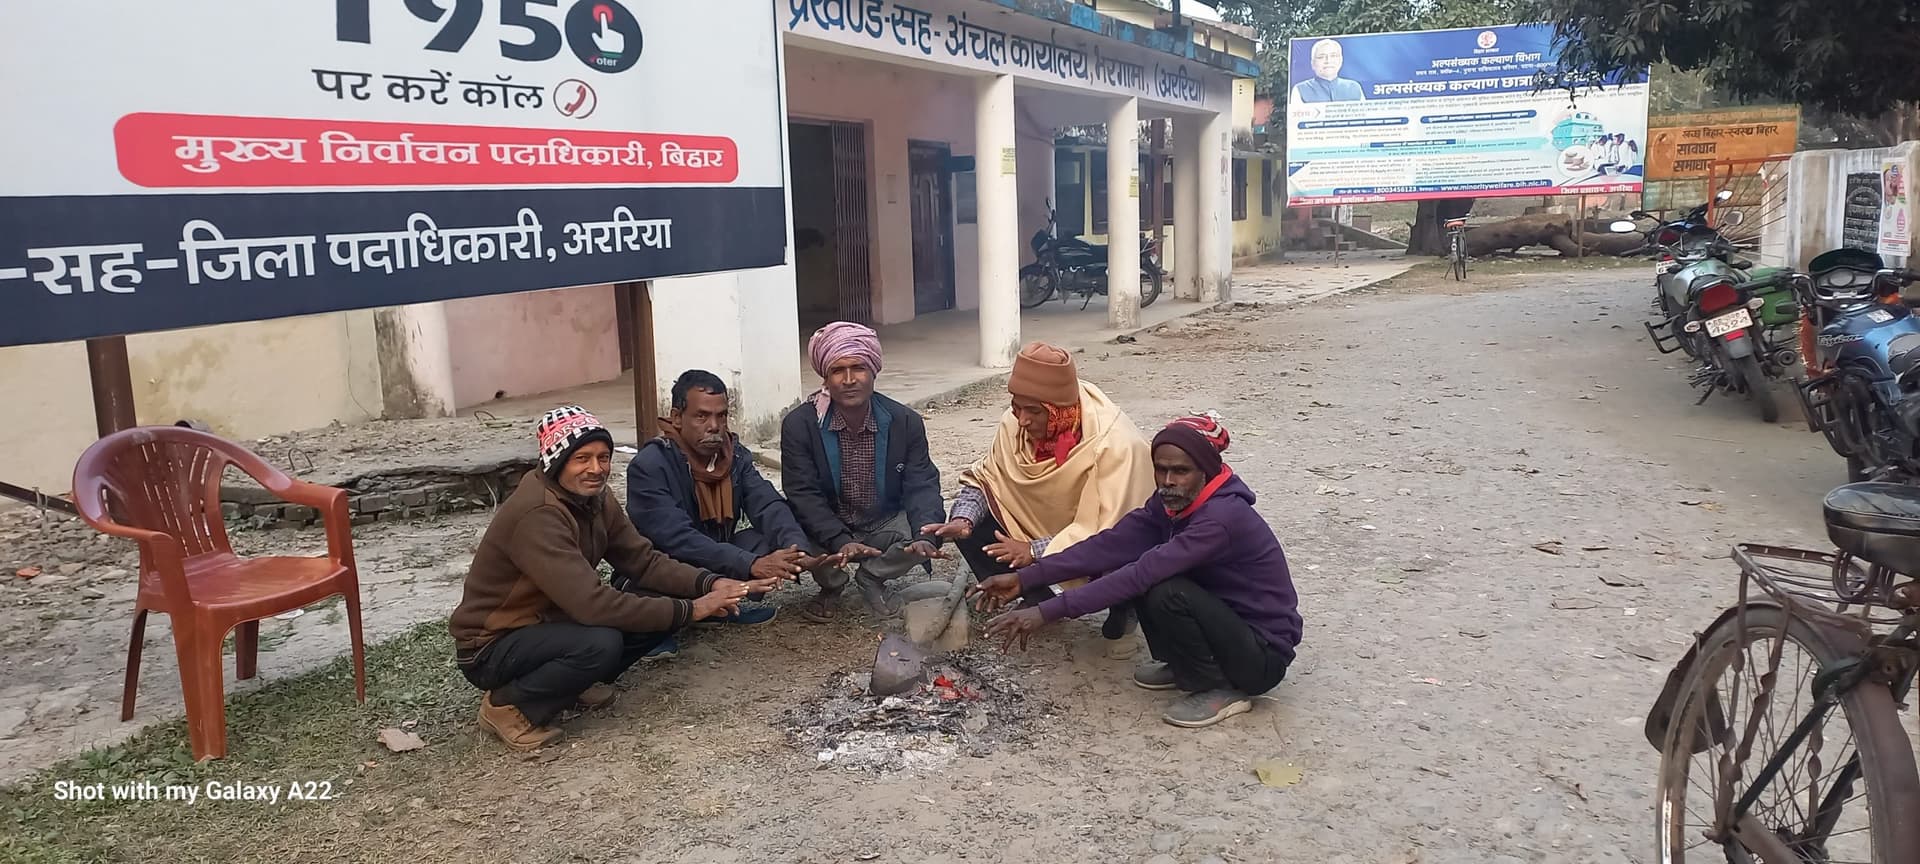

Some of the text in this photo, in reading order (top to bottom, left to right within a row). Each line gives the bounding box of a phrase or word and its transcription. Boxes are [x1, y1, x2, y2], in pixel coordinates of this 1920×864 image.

[945, 12, 1007, 66] अंचल
[1432, 52, 1541, 68] अल्पसंख्यक कल्याण विभाग
[311, 69, 545, 108] पर करें कॉल
[1373, 80, 1446, 95] अल्पसंख्यक
[1450, 77, 1499, 91] कल्याण
[1756, 125, 1778, 136] बिहार
[172, 131, 724, 172] मुख्य निर्वाचन पदाधिकारी, बिहार
[1677, 142, 1716, 155] सावधान
[326, 212, 556, 274] पदाधिकारी,
[563, 206, 672, 255] अररिया
